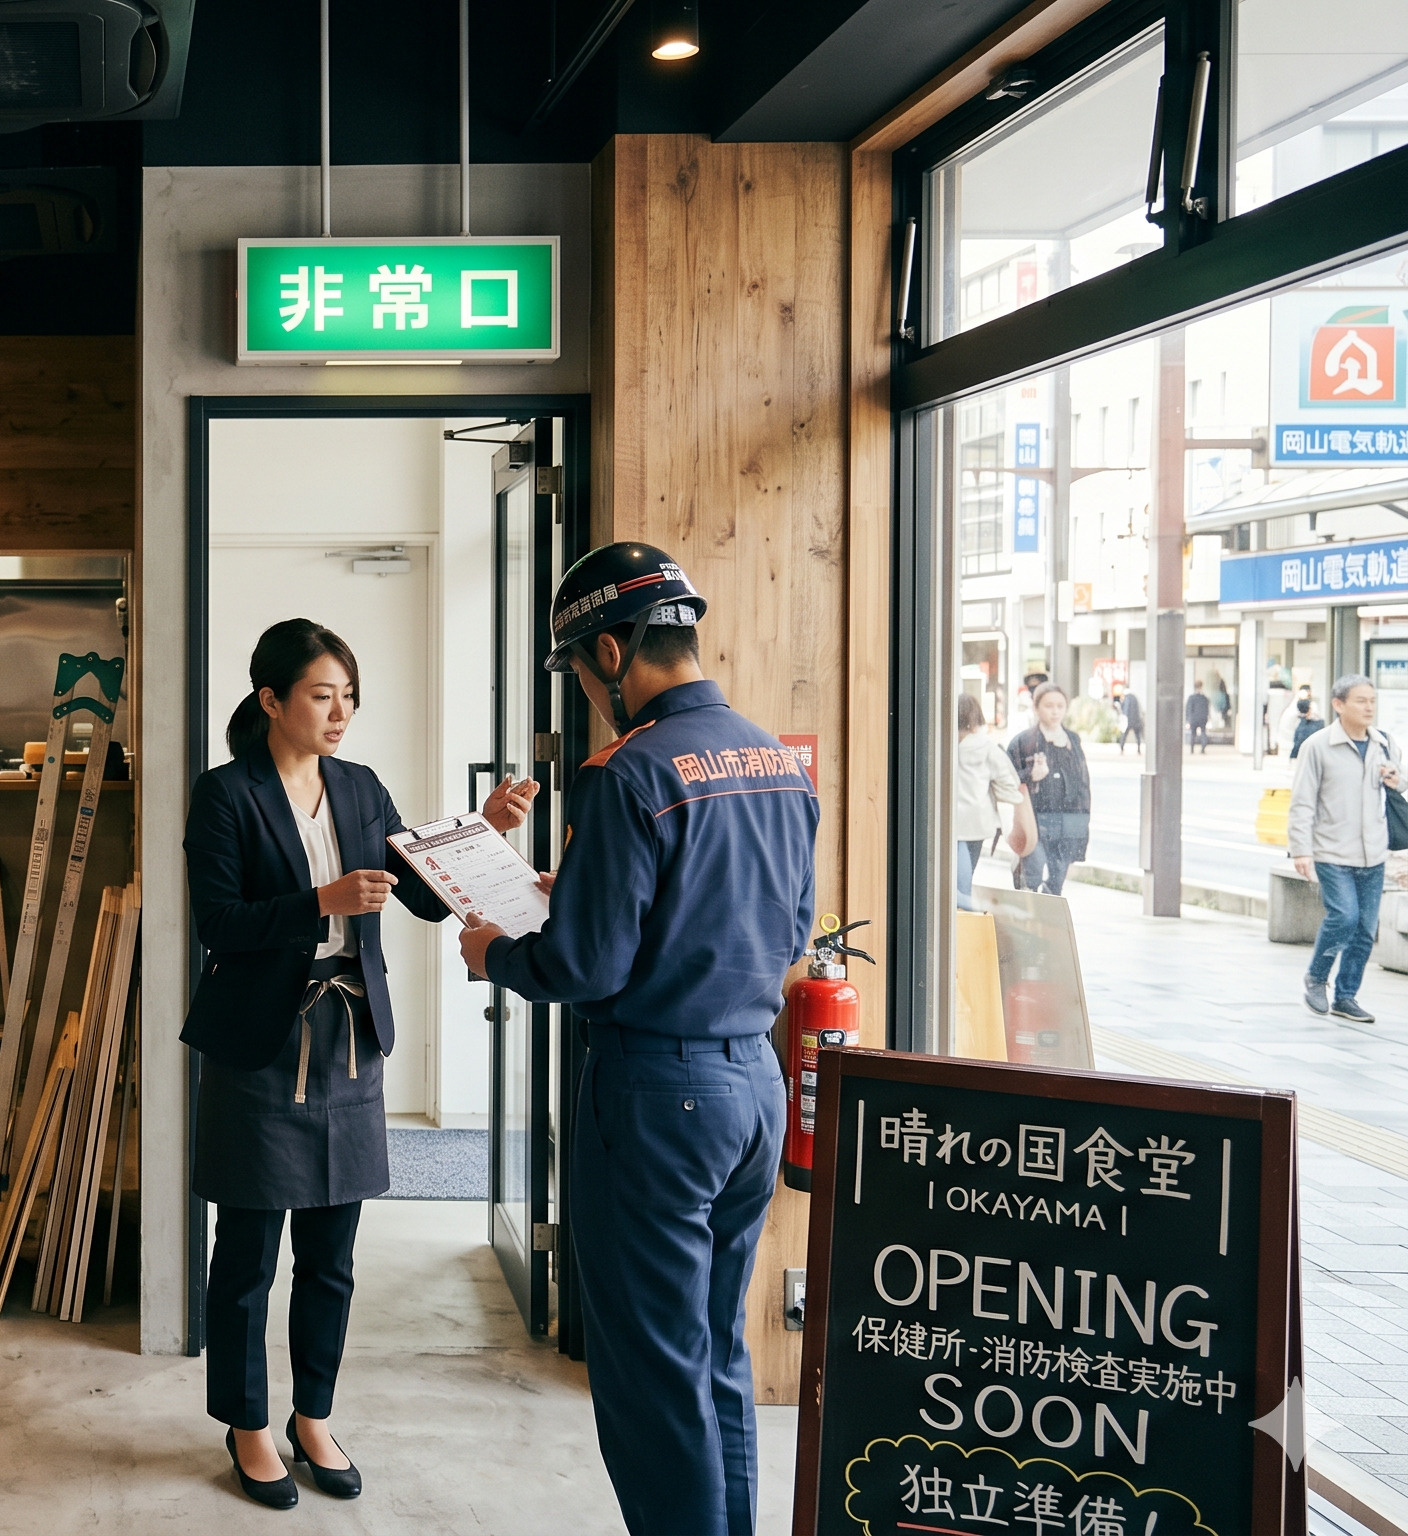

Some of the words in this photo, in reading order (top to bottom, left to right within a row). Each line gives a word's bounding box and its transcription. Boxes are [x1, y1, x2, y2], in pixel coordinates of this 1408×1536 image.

[279, 264, 518, 332] 非常口
[672, 746, 802, 786] 岡山市消防局
[879, 1106, 1197, 1202] 晴れの国食堂
[945, 1185, 1106, 1231] OKAYAMA
[872, 1243, 1220, 1359] OPENING
[918, 1372, 1151, 1466] SOON
